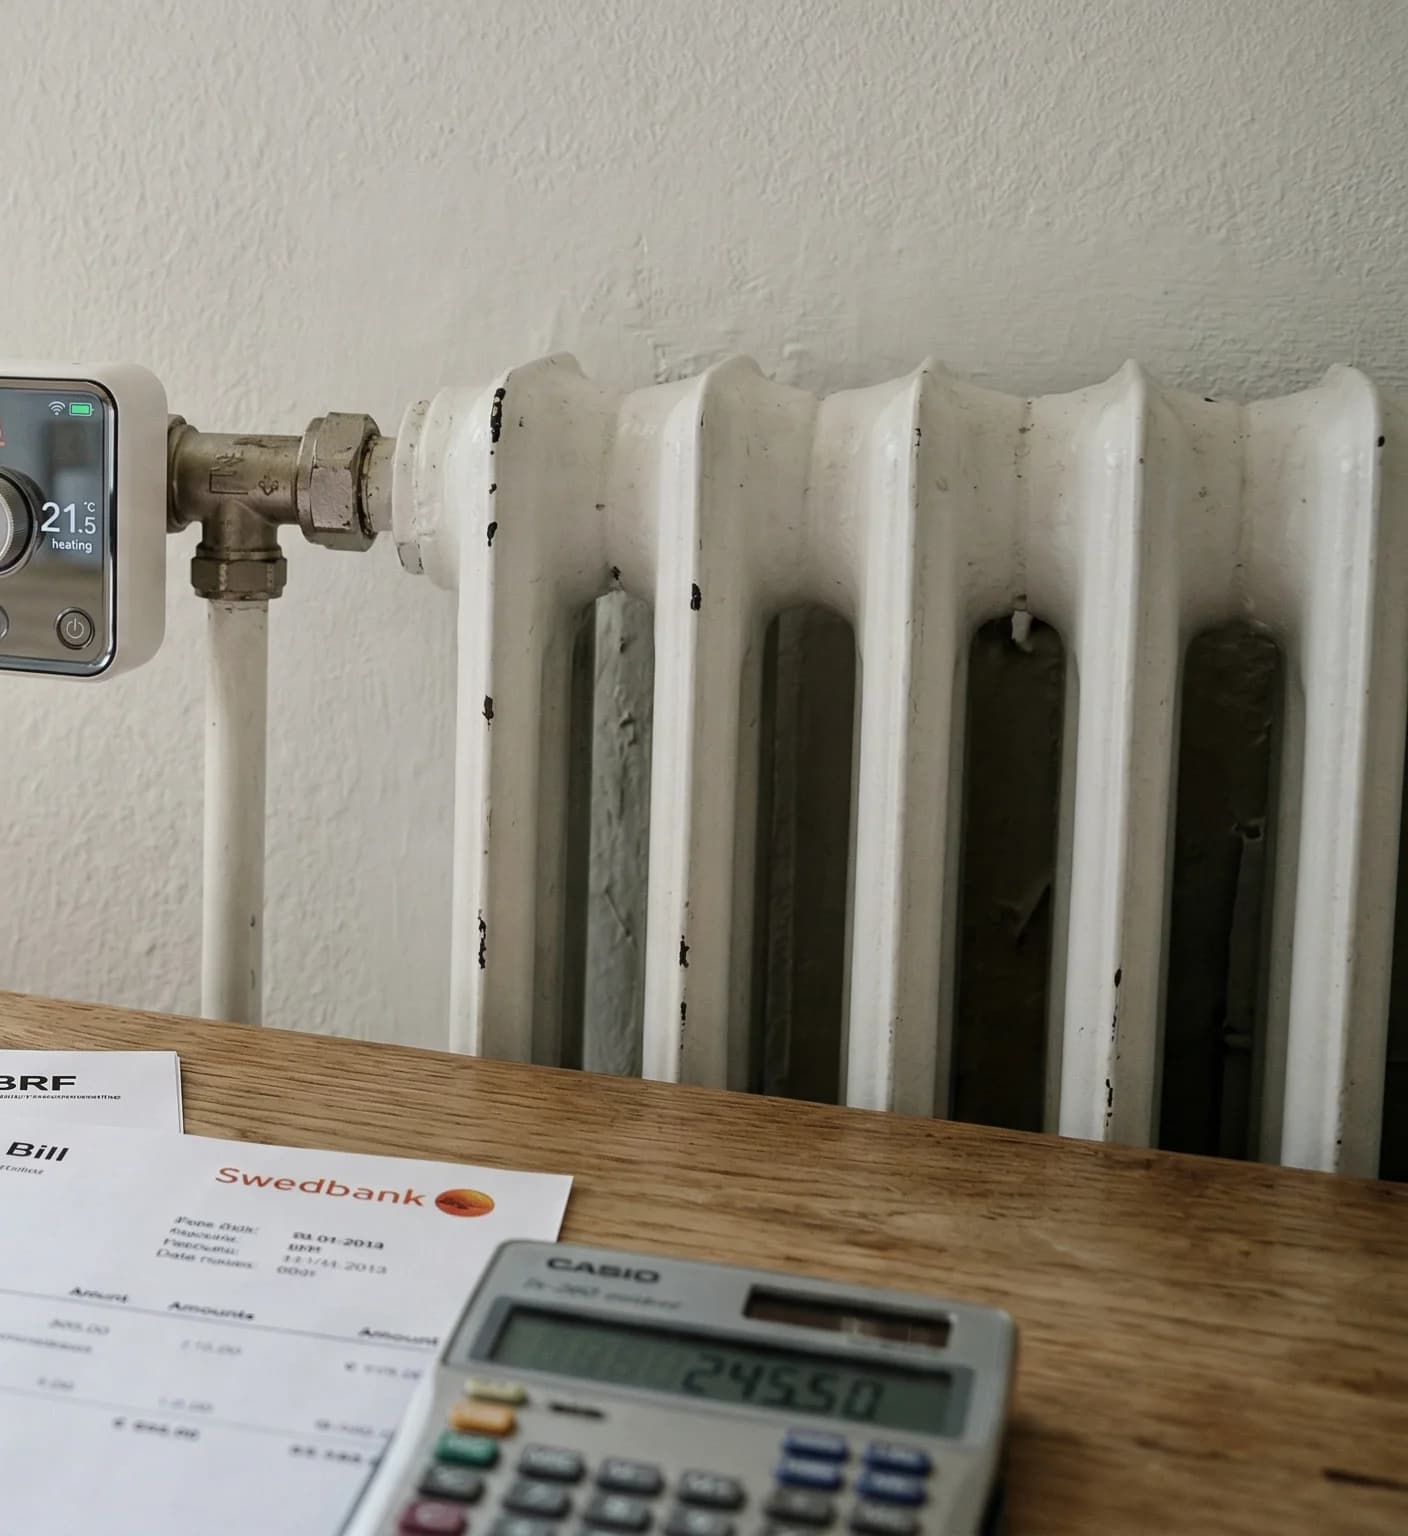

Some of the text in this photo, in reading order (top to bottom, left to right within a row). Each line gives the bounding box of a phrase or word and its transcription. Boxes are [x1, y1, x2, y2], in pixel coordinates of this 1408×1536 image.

[40, 501, 96, 535] 21.5
[52, 538, 93, 554] heating
[5, 1141, 70, 1162] Bill
[215, 1166, 427, 1208] Swedbank
[546, 1256, 661, 1285] CASIO
